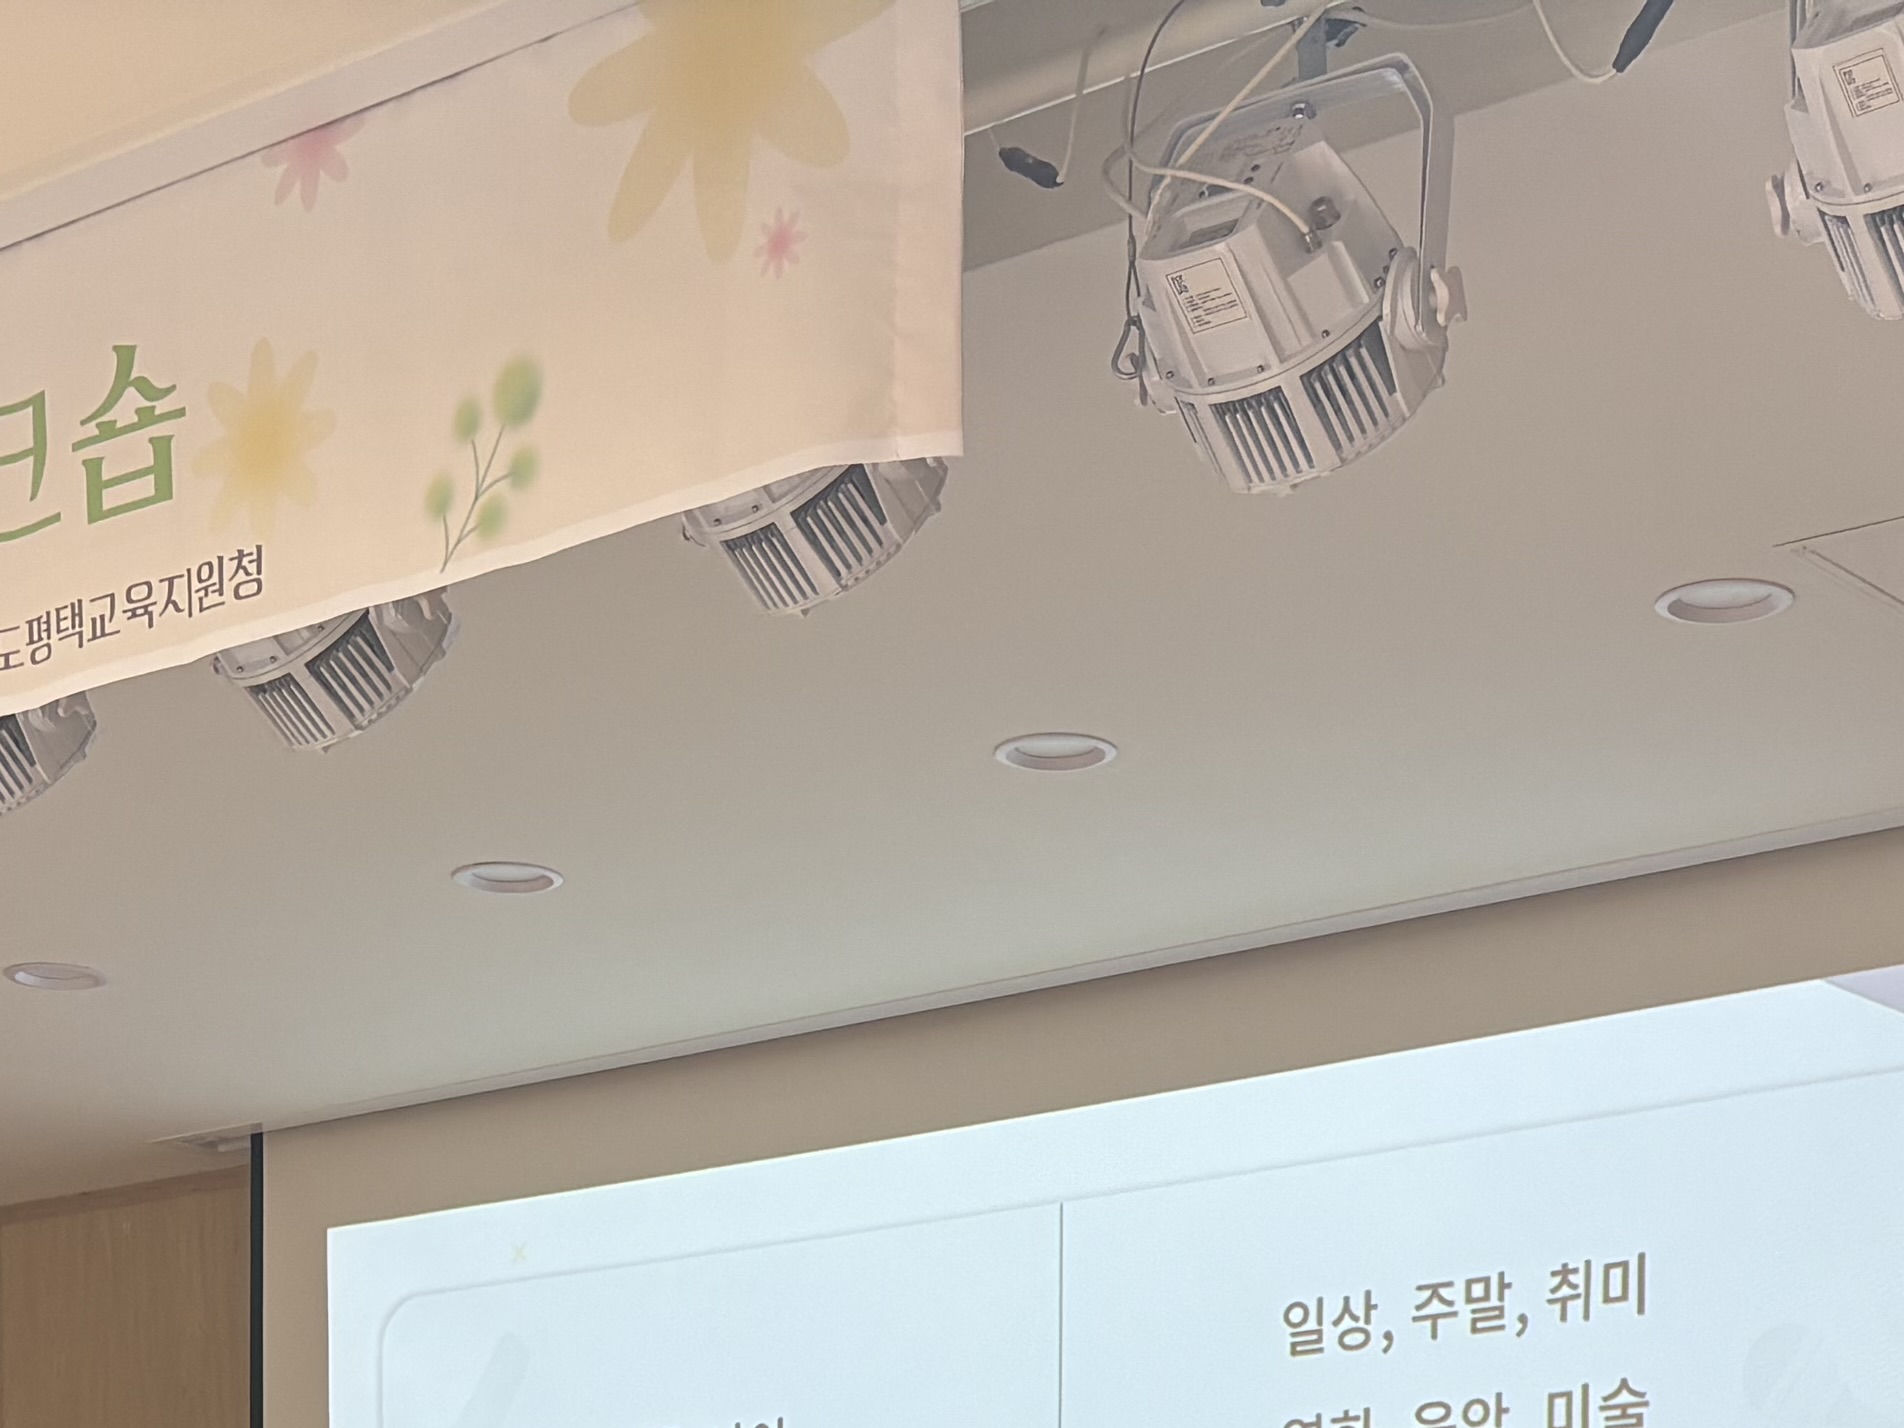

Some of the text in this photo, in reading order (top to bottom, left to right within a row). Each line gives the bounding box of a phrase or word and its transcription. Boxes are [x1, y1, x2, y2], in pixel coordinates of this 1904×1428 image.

[1282, 1251, 1650, 1359] 일상, 주말, 취미
